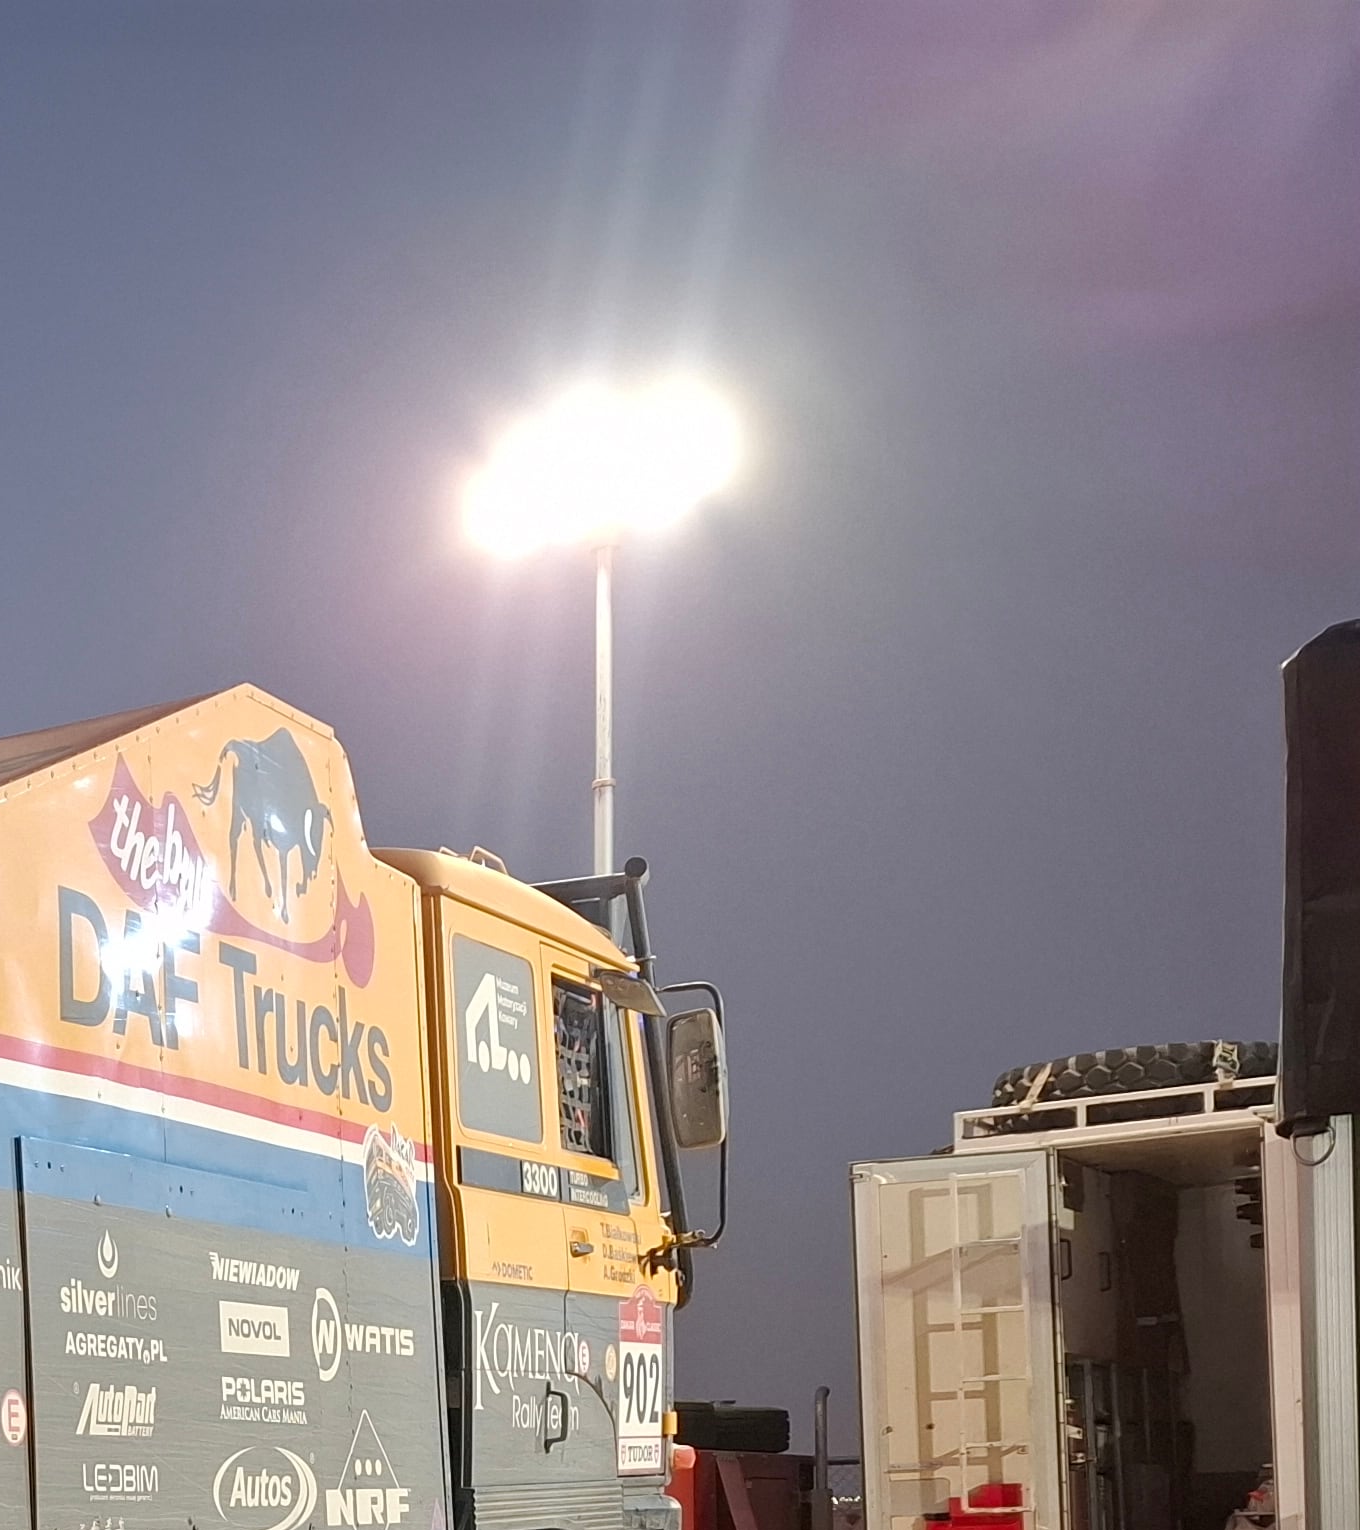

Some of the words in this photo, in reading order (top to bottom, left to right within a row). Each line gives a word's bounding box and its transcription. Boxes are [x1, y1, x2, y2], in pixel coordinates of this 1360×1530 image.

[111, 794, 161, 890] the
[219, 941, 393, 1114] Trucks
[522, 1162, 558, 1197] 3300
[501, 1263, 533, 1281] DOMETIC
[60, 1278, 158, 1321] silverlines
[228, 1317, 282, 1341] NOVOL
[344, 1323, 415, 1356] WATIS
[221, 1376, 305, 1406] POLARIS
[623, 1351, 660, 1425] 902
[128, 1426, 154, 1437] BATTERY
[512, 1394, 544, 1437] Rally
[627, 1445, 654, 1463] TUDOR
[82, 1463, 159, 1493] LEDBIM
[229, 1466, 293, 1509] Autos
[325, 1487, 411, 1527] NRF
